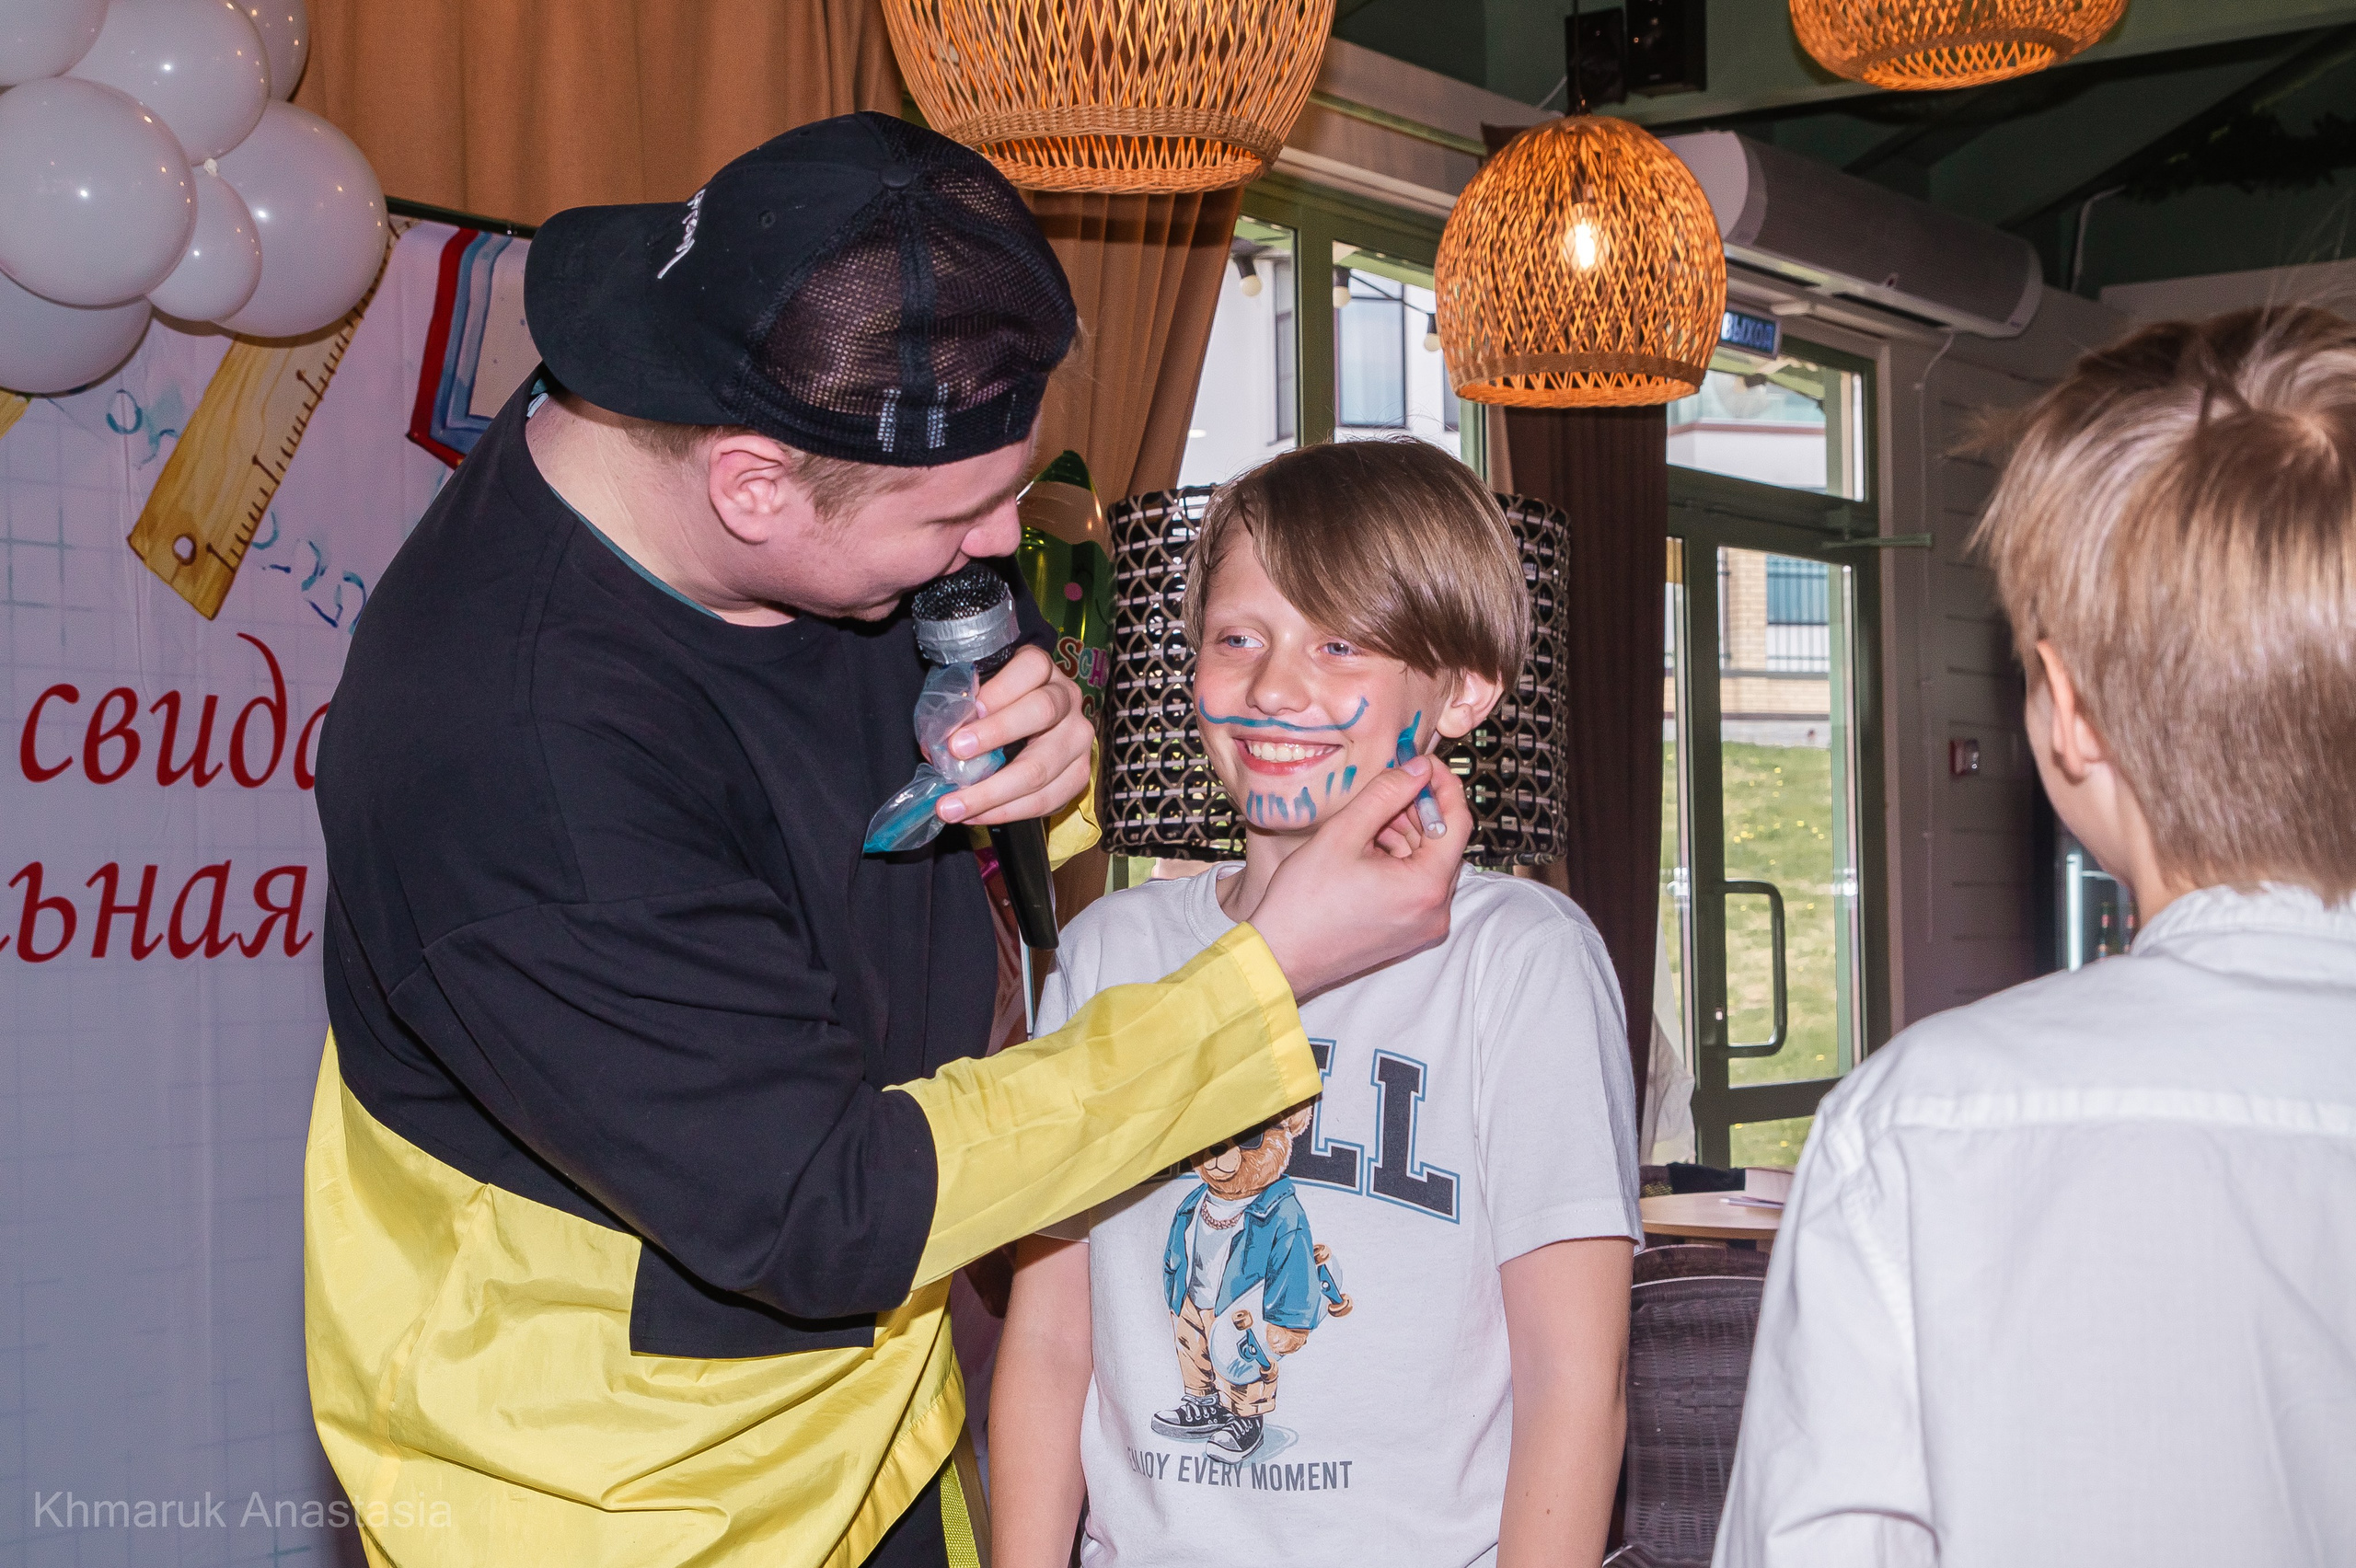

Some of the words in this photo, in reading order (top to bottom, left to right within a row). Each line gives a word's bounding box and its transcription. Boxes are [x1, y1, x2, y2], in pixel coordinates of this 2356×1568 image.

[0, 859, 314, 963] ьная
[1178, 1455, 1242, 1488] EVERY
[1252, 1461, 1352, 1492] MOMENT
